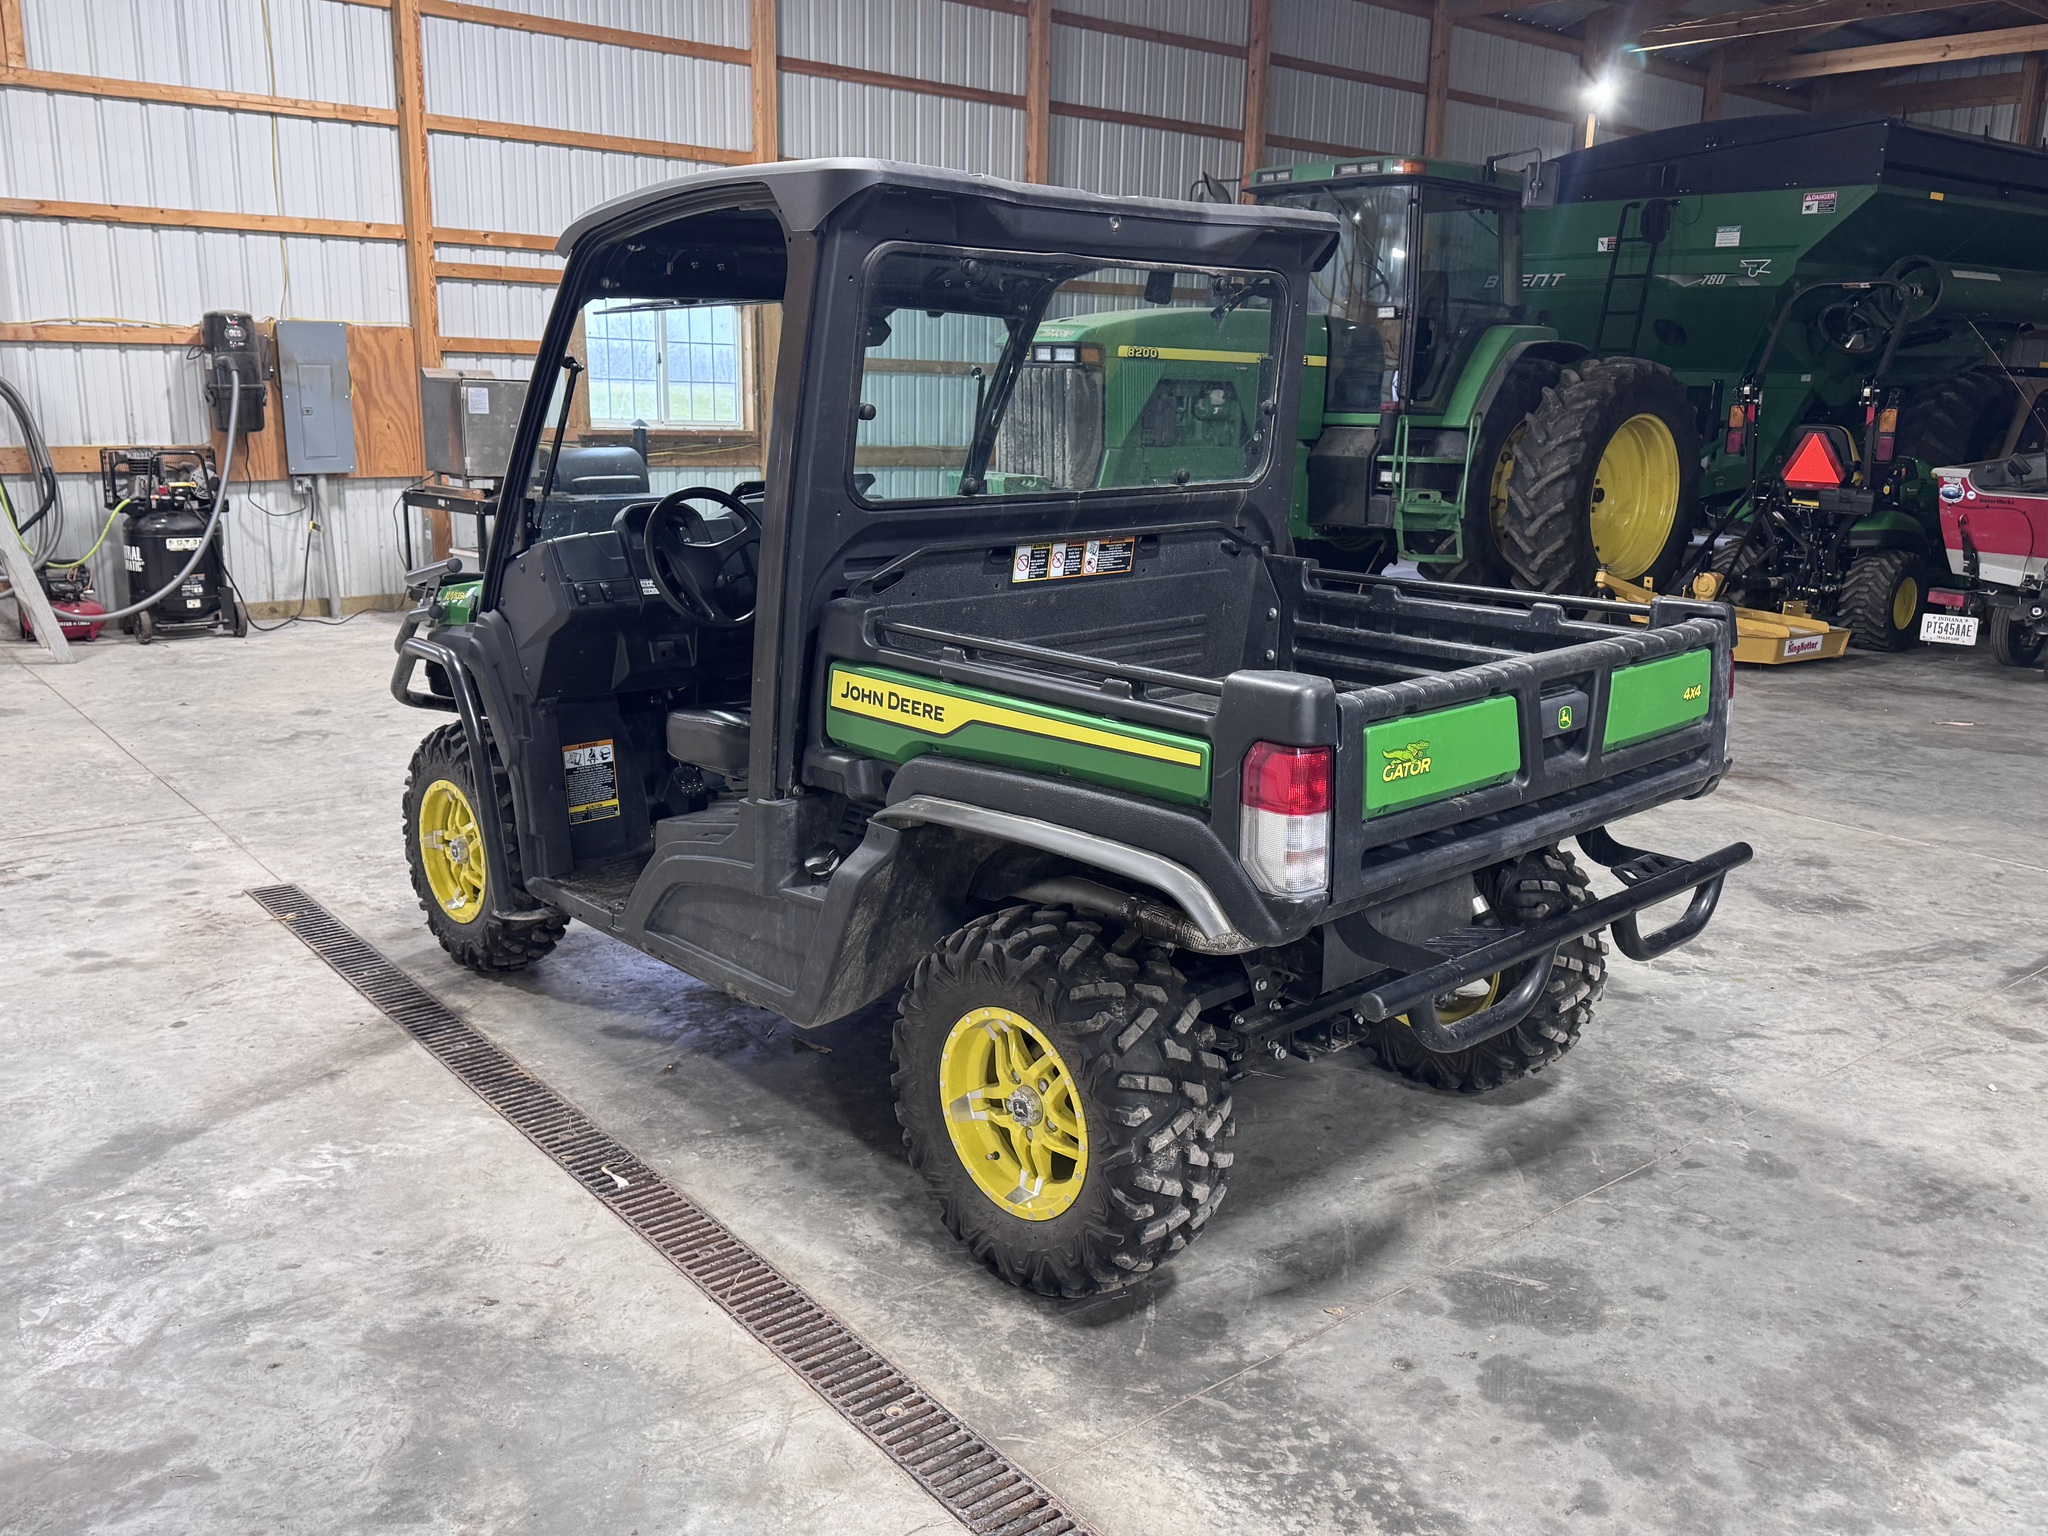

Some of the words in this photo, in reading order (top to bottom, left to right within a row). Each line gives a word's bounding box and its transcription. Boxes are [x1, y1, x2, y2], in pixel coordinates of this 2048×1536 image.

[1483, 273, 1566, 288] BENT
[1701, 274, 1726, 285] 780
[1127, 347, 1158, 359] 8200
[1926, 620, 1973, 637] PT545AAE
[840, 680, 884, 708] JOHN
[887, 690, 945, 722] DEERE
[1382, 756, 1432, 783] GATOR
